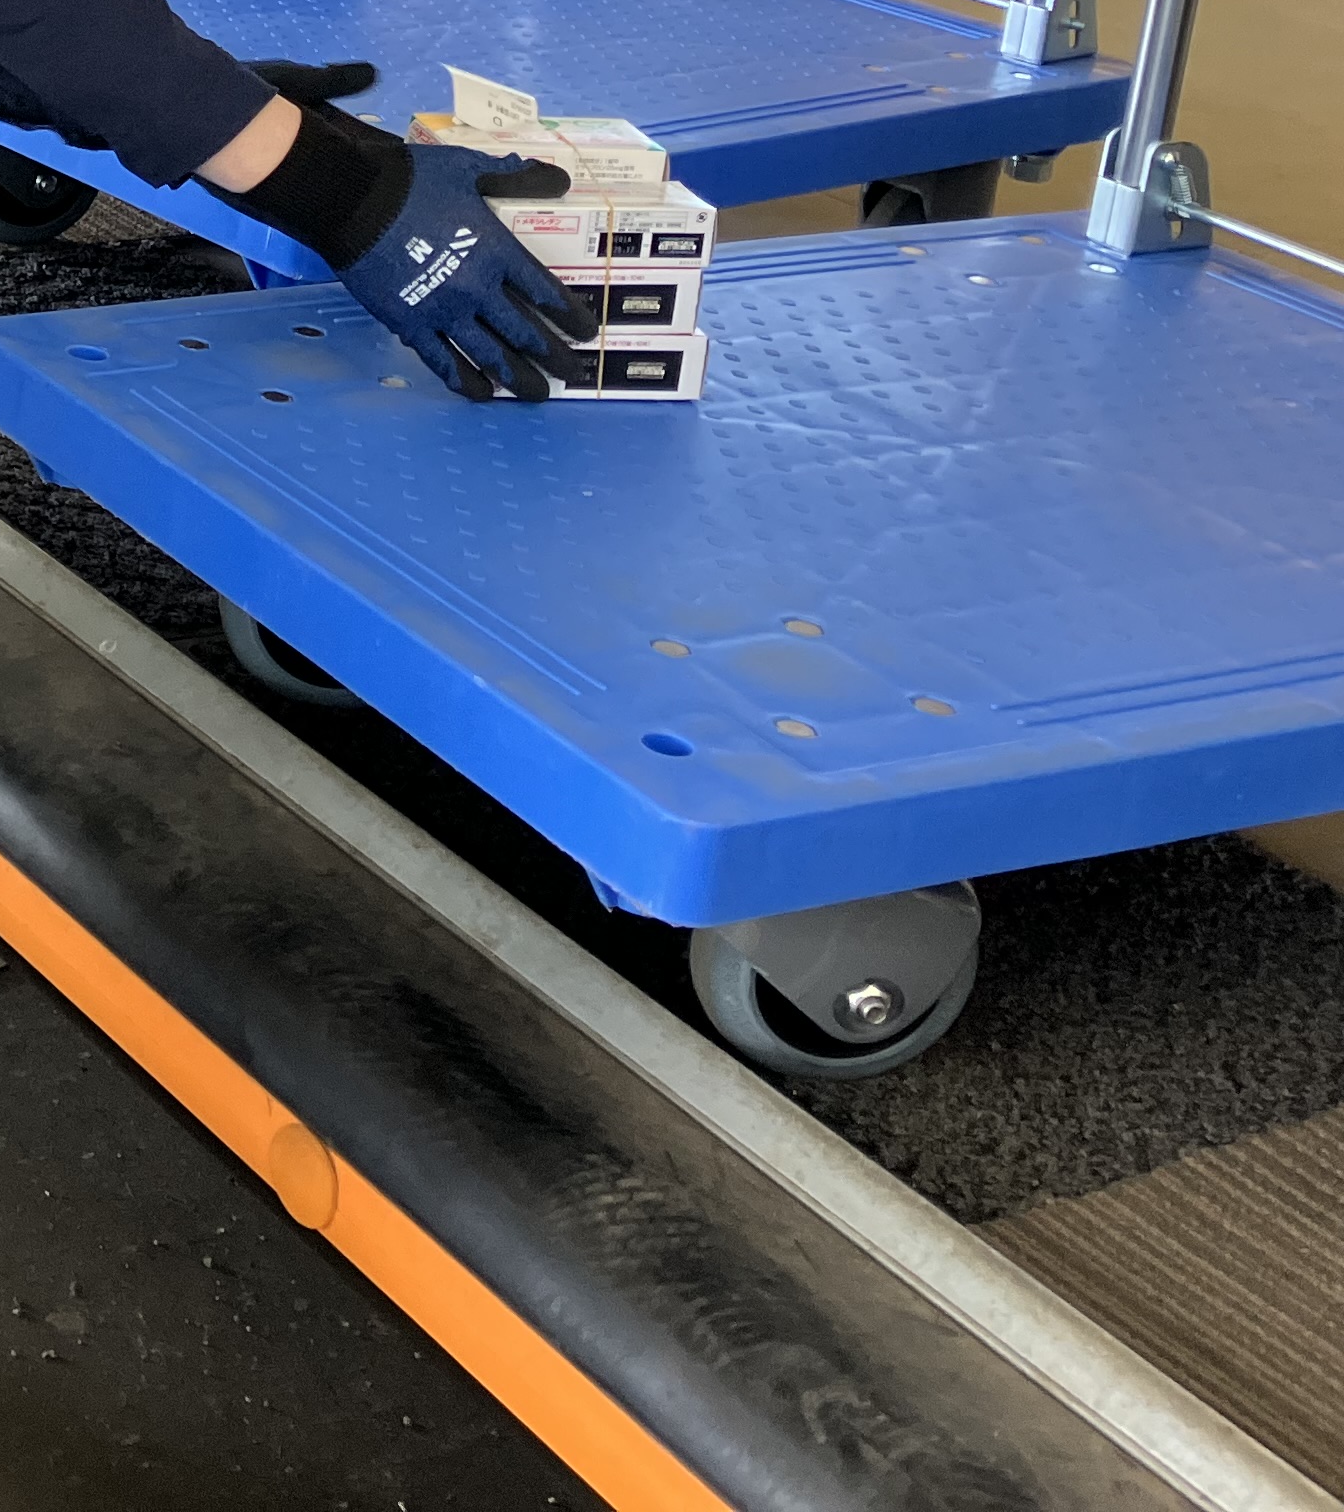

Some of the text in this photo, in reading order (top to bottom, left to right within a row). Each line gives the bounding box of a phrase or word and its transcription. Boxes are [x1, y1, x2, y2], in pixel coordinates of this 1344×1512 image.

[408, 238, 434, 264] M
[426, 250, 451, 275] TOUCH
[404, 255, 461, 306] SUPER
